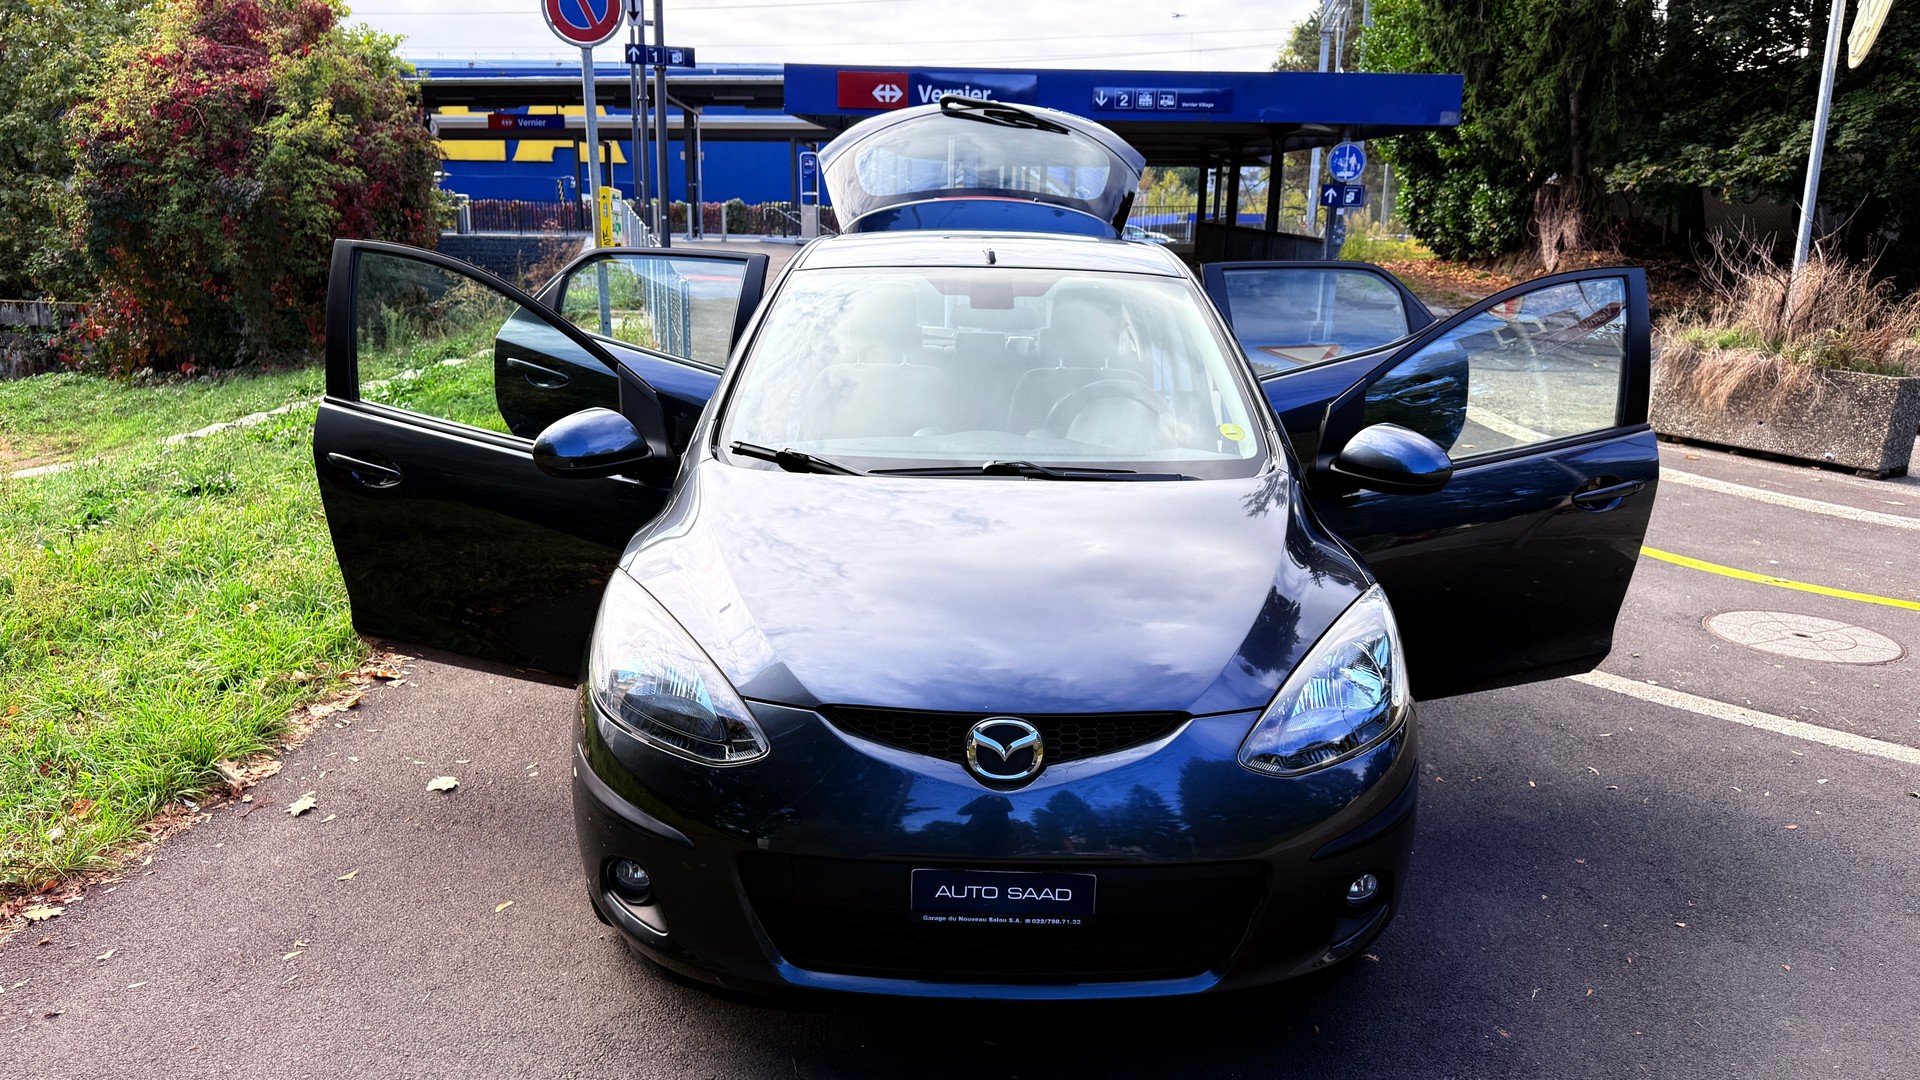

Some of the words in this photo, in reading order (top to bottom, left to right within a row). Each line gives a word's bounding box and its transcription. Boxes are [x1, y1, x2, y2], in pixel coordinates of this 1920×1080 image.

[652, 51, 658, 62] 1
[1120, 94, 1128, 107] 2
[517, 118, 547, 127] Vernier
[934, 885, 999, 899] AUTO
[1007, 886, 1072, 901] SAAD
